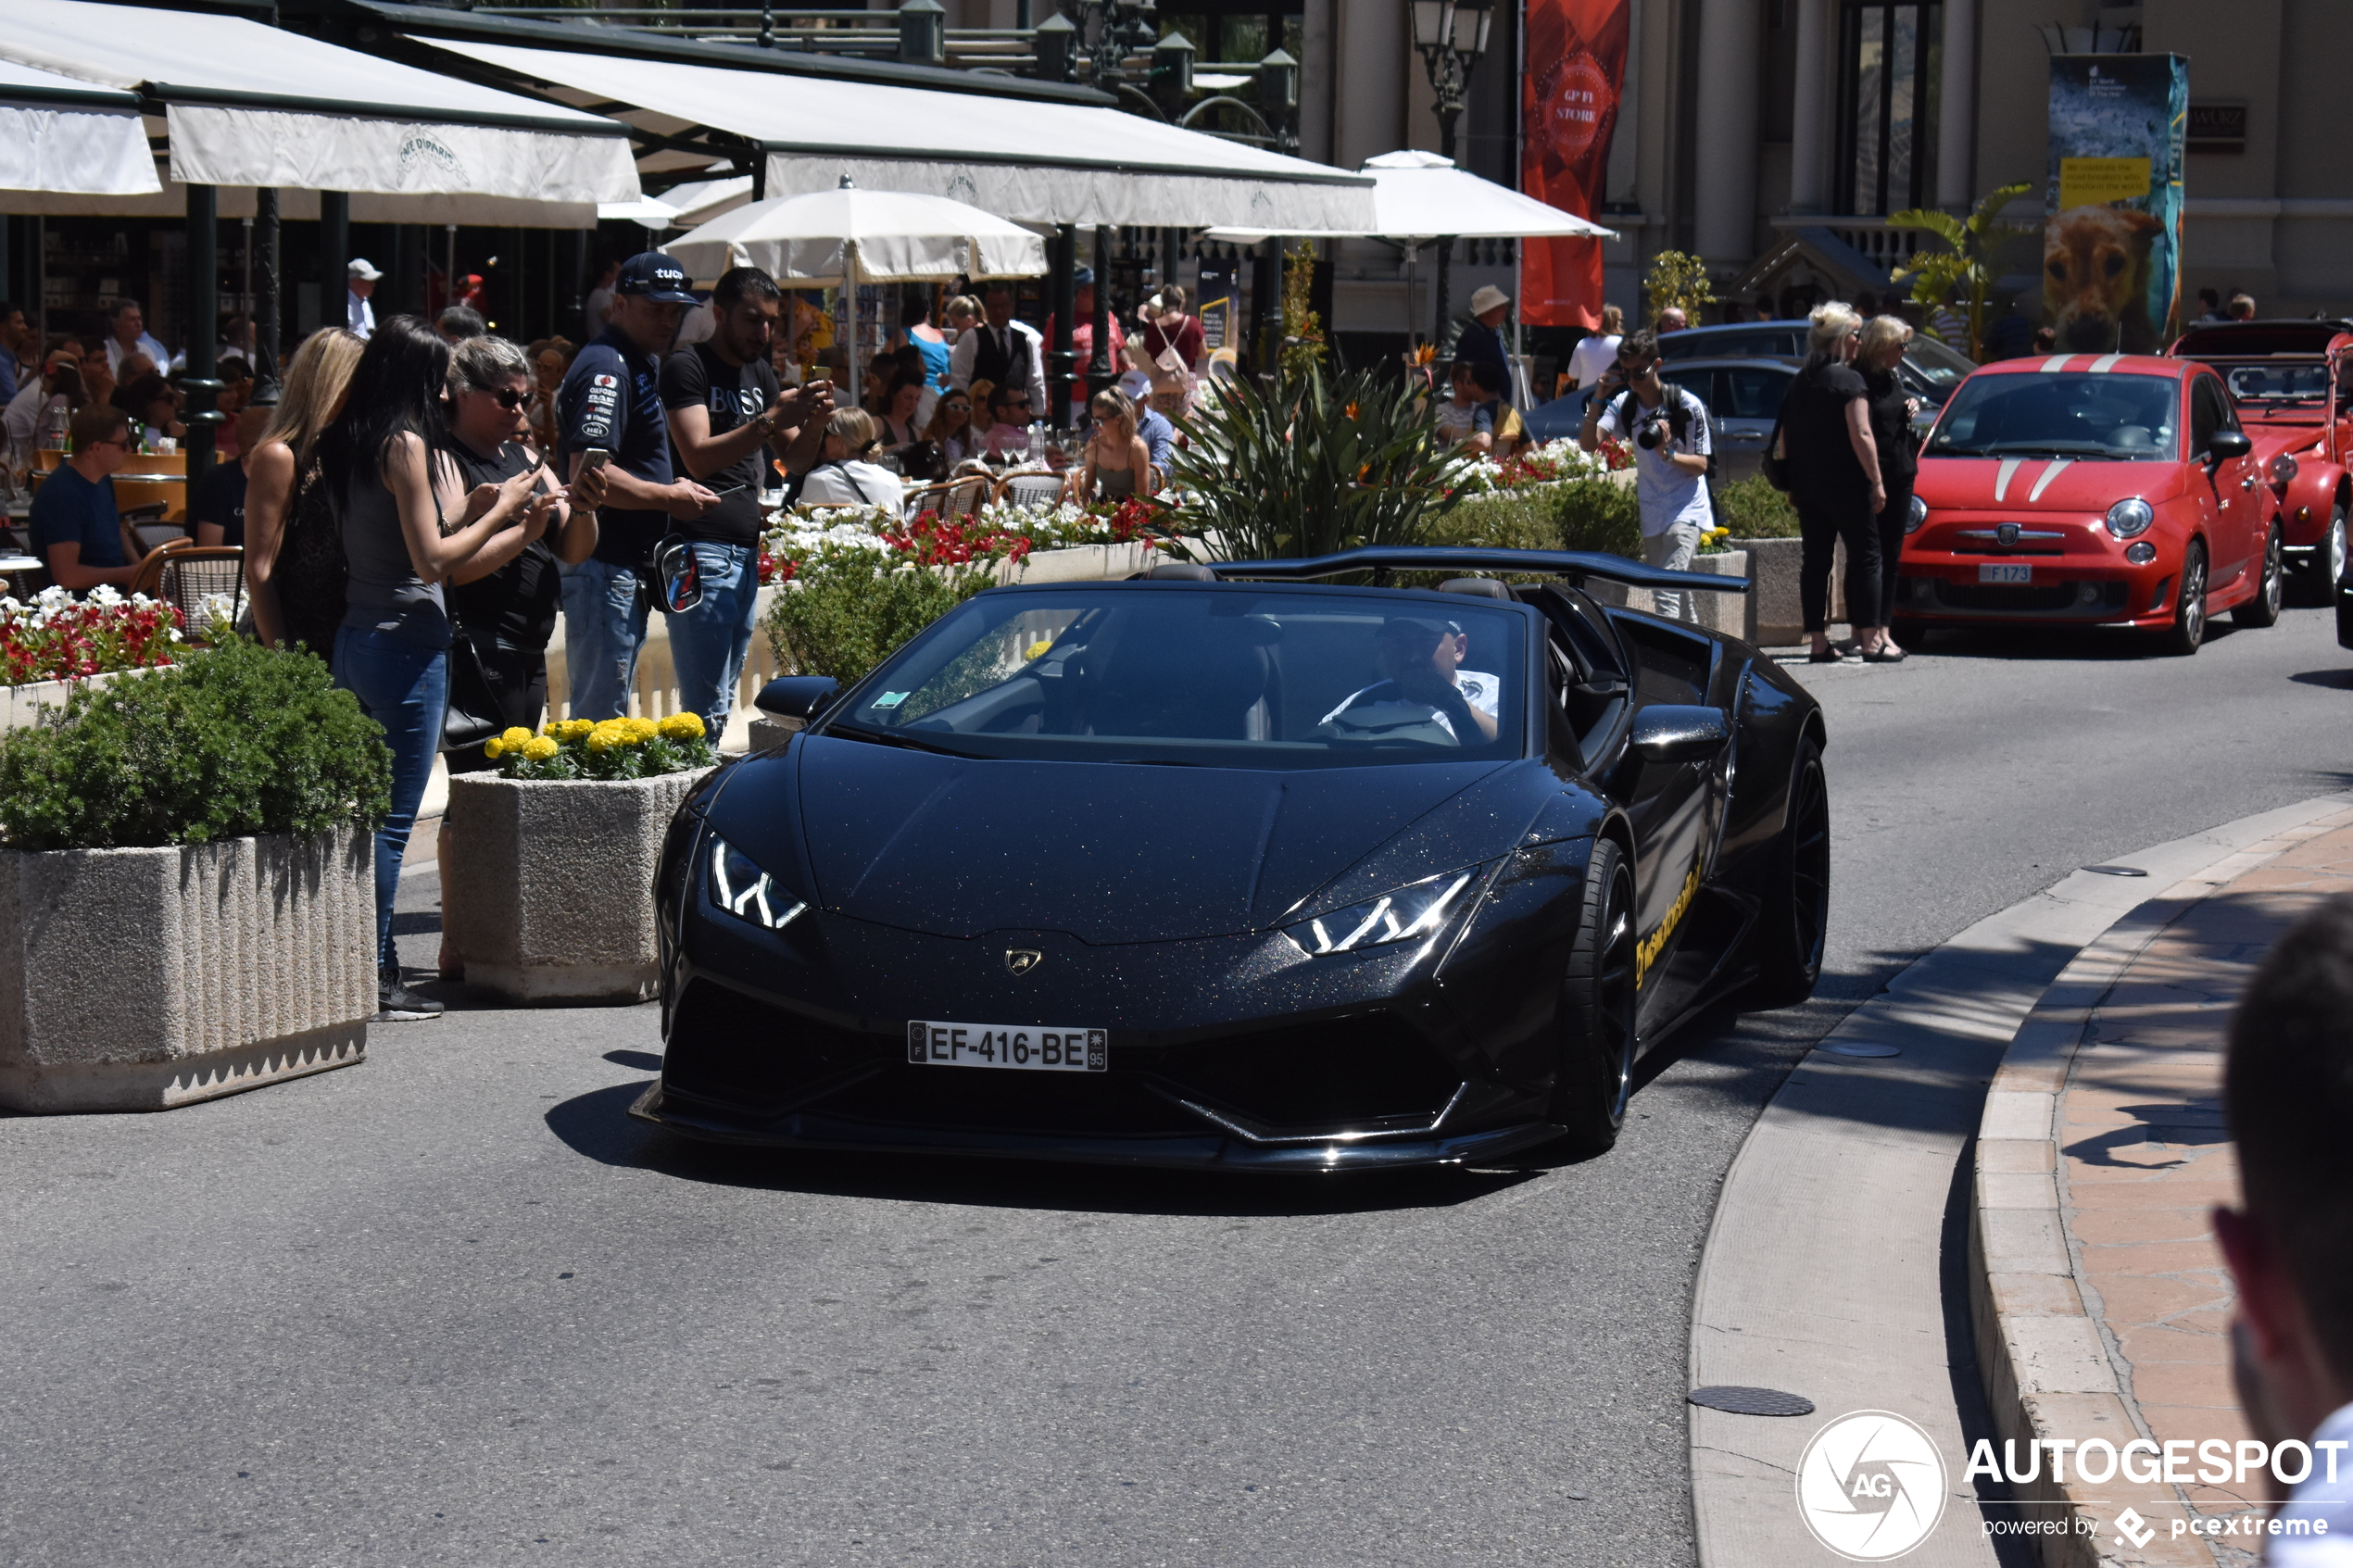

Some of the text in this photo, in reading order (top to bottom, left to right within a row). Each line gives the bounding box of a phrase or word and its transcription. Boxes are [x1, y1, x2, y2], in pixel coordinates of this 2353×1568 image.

[1565, 89, 1580, 102] GP
[1556, 107, 1594, 122] STORE
[426, 140, 454, 165] PARIS
[655, 268, 684, 280] tuco
[589, 387, 617, 397] OXFORD
[588, 394, 615, 405] DAF
[709, 386, 764, 415] BOSS
[1992, 567, 2029, 581] F173
[914, 1027, 1103, 1066] F EF-416-BE 95
